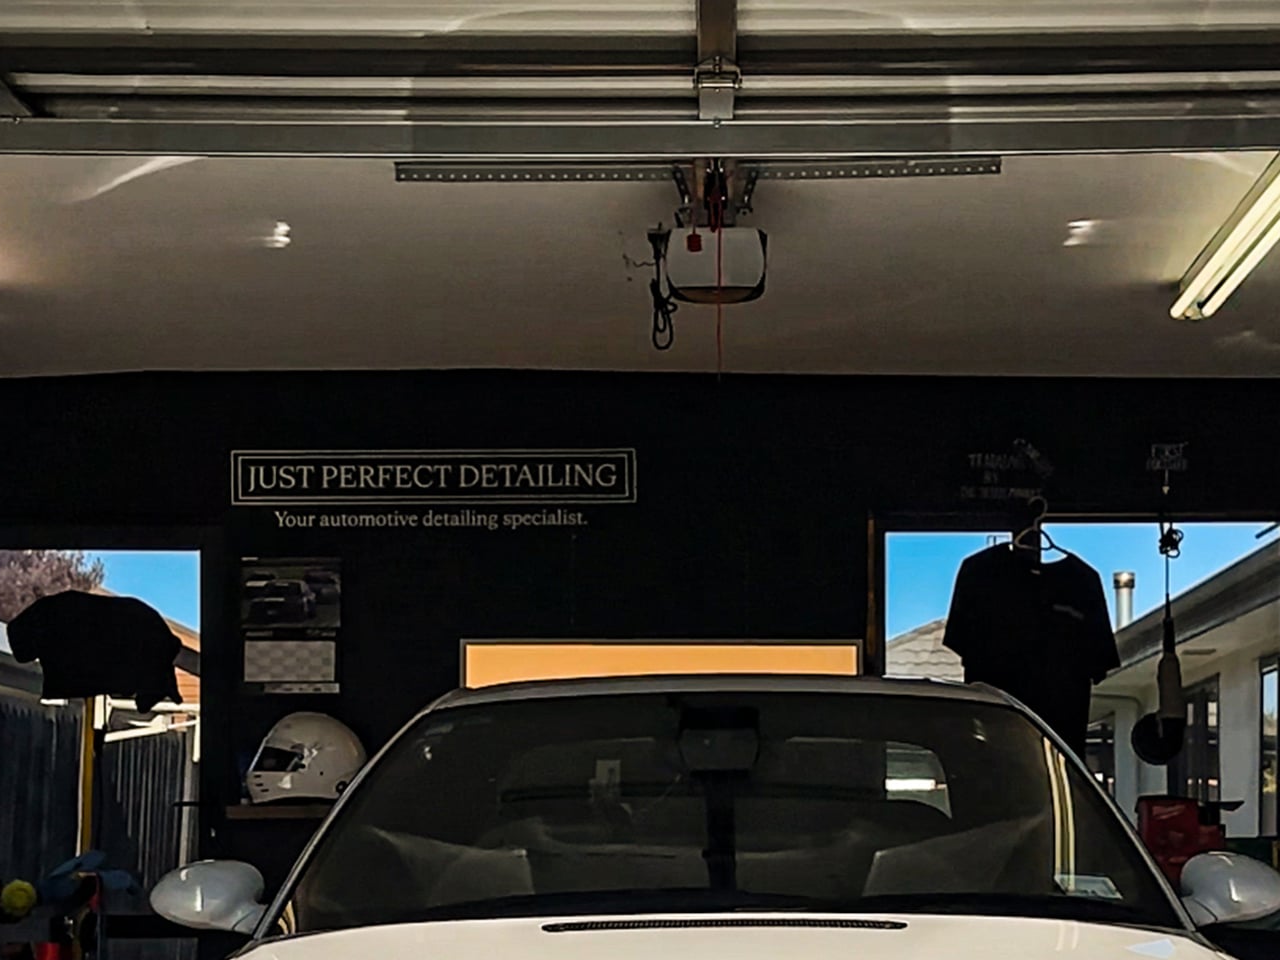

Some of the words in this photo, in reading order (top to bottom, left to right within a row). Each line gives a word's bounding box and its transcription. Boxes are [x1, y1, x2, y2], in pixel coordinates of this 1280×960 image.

[248, 465, 315, 492] JUST
[322, 464, 452, 489] PERFECT
[459, 463, 617, 488] DETAILING
[274, 510, 316, 528] Your
[319, 510, 418, 528] automotive
[422, 509, 498, 530] detailing
[503, 509, 588, 530] specialist.
